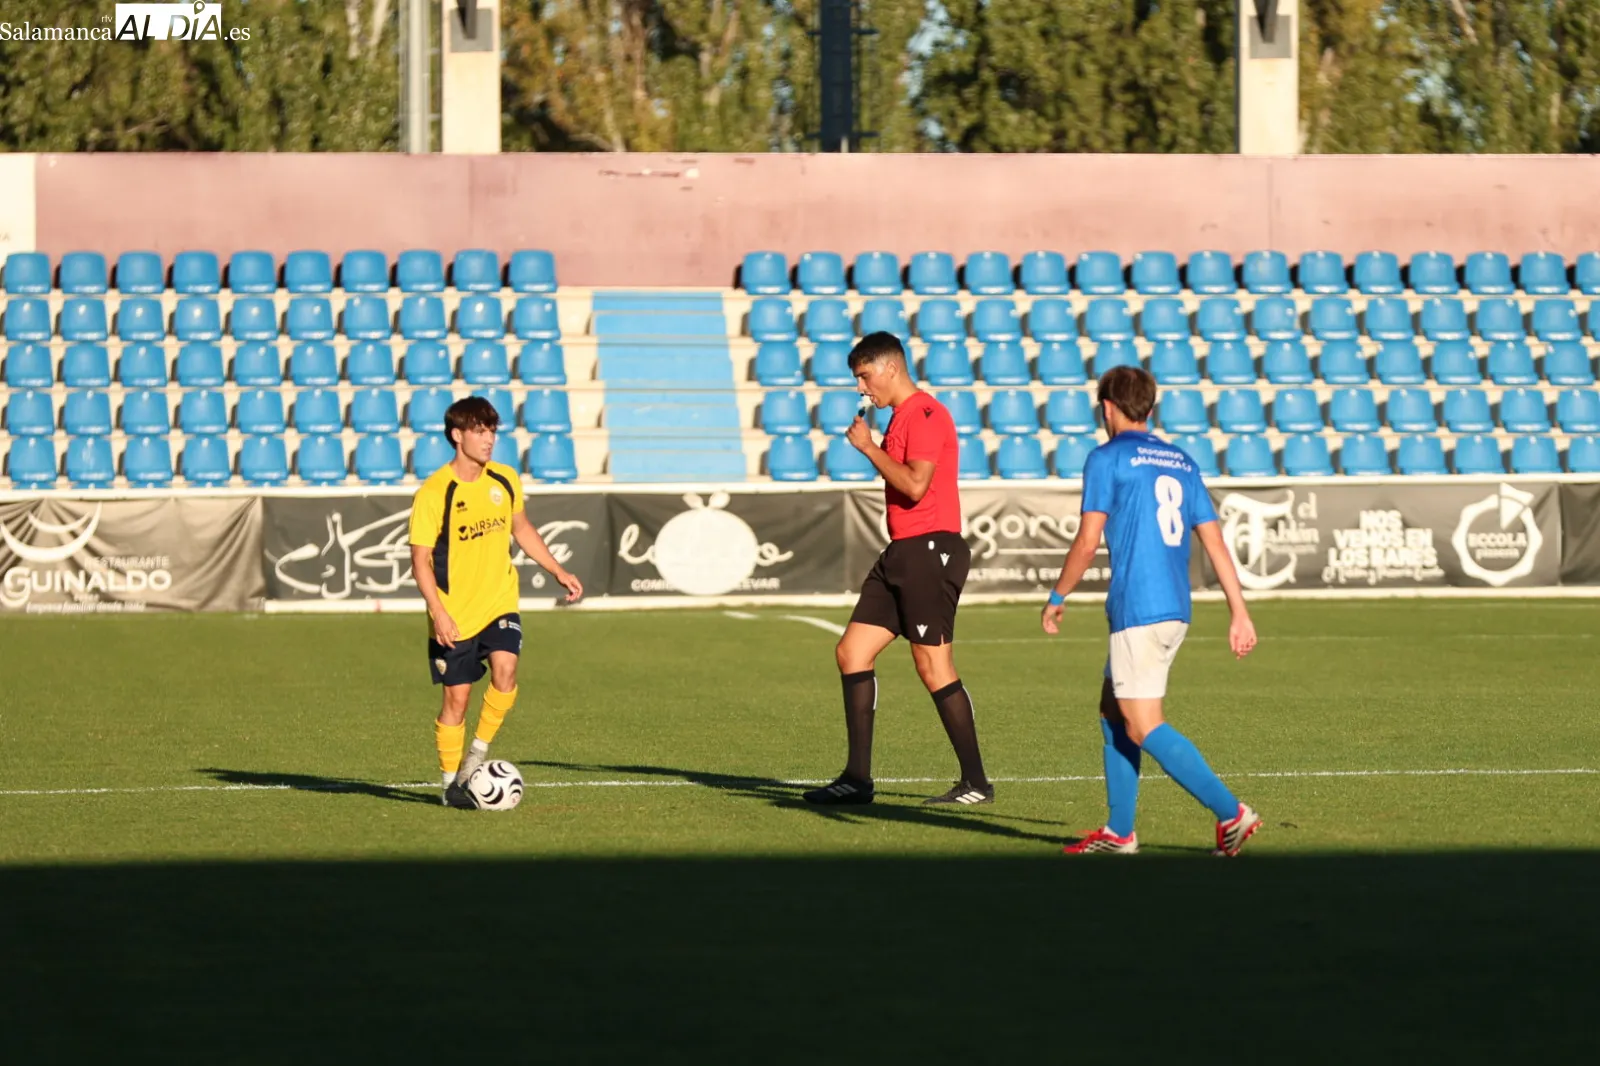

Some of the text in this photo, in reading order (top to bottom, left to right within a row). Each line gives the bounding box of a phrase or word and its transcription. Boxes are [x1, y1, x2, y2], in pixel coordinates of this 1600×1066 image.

[1154, 474, 1184, 547] 8
[1359, 509, 1402, 530] NOS
[1332, 529, 1404, 549] VEMOS
[1405, 528, 1432, 549] EN
[1467, 532, 1528, 548] ECCOLA
[84, 555, 170, 568] RESTAURANTE
[1327, 547, 1369, 568] LOS
[1370, 547, 1438, 568] BARES
[0, 566, 173, 608] GUINALDO
